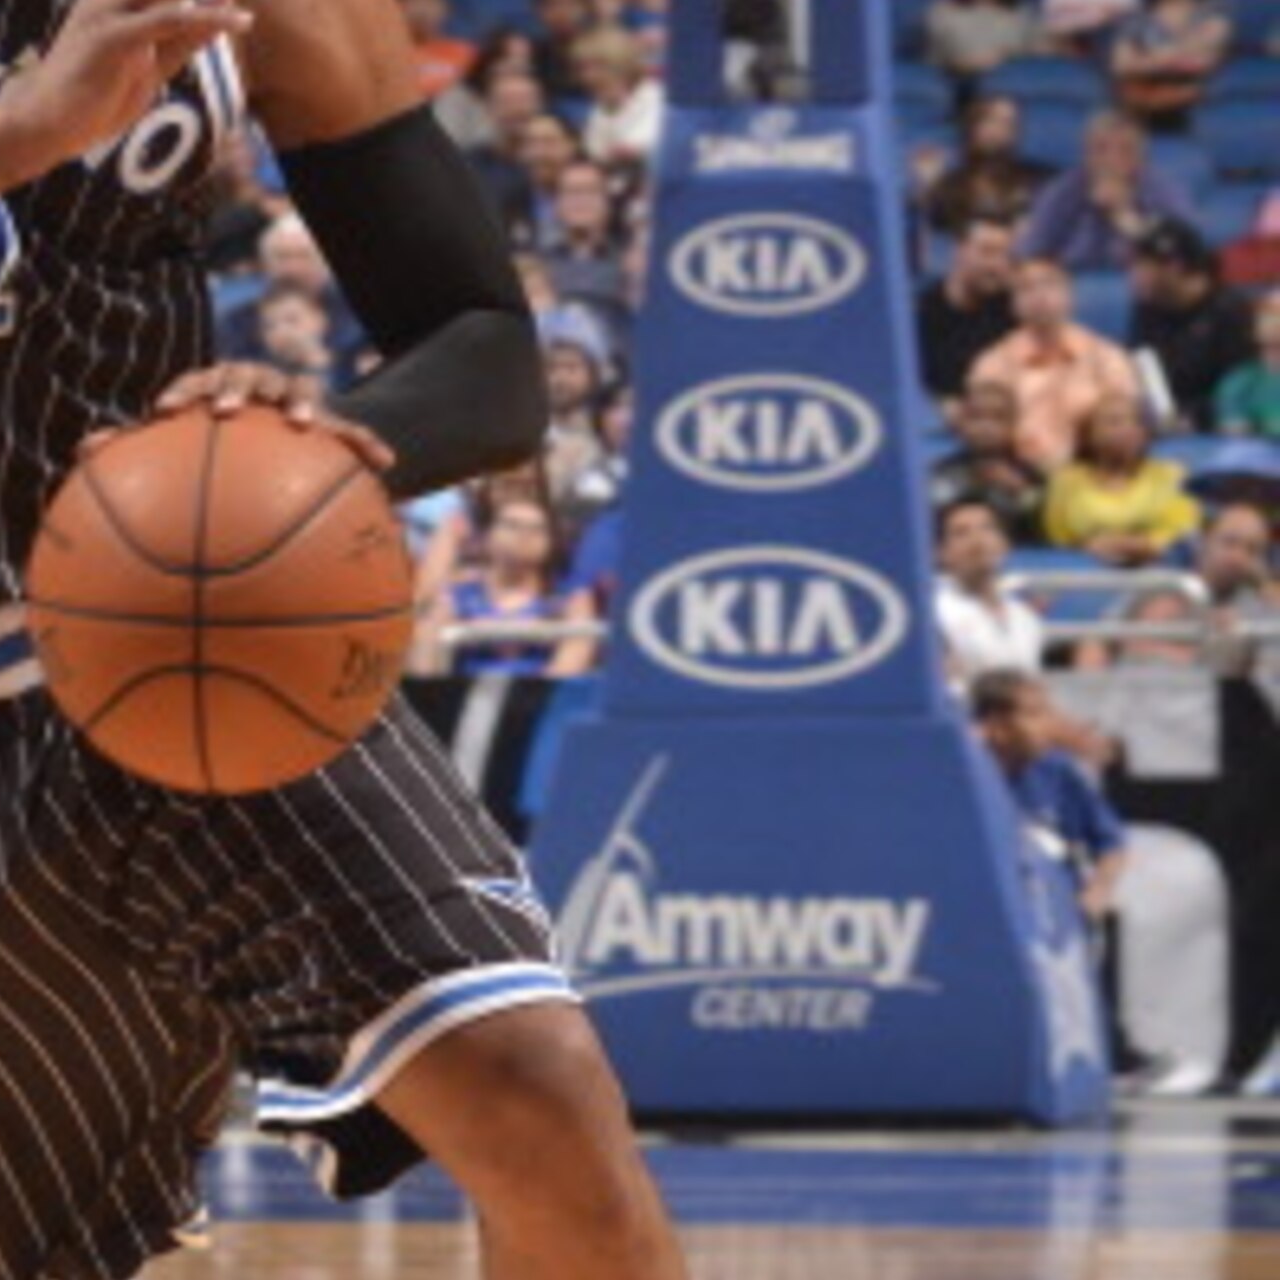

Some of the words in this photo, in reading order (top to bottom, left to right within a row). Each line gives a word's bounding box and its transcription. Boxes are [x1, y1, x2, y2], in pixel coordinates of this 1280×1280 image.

[703, 234, 830, 292] KIA
[696, 398, 842, 464] KIA
[678, 578, 860, 656] KIA
[584, 871, 930, 991] Amway
[689, 987, 875, 1030] CENTER
